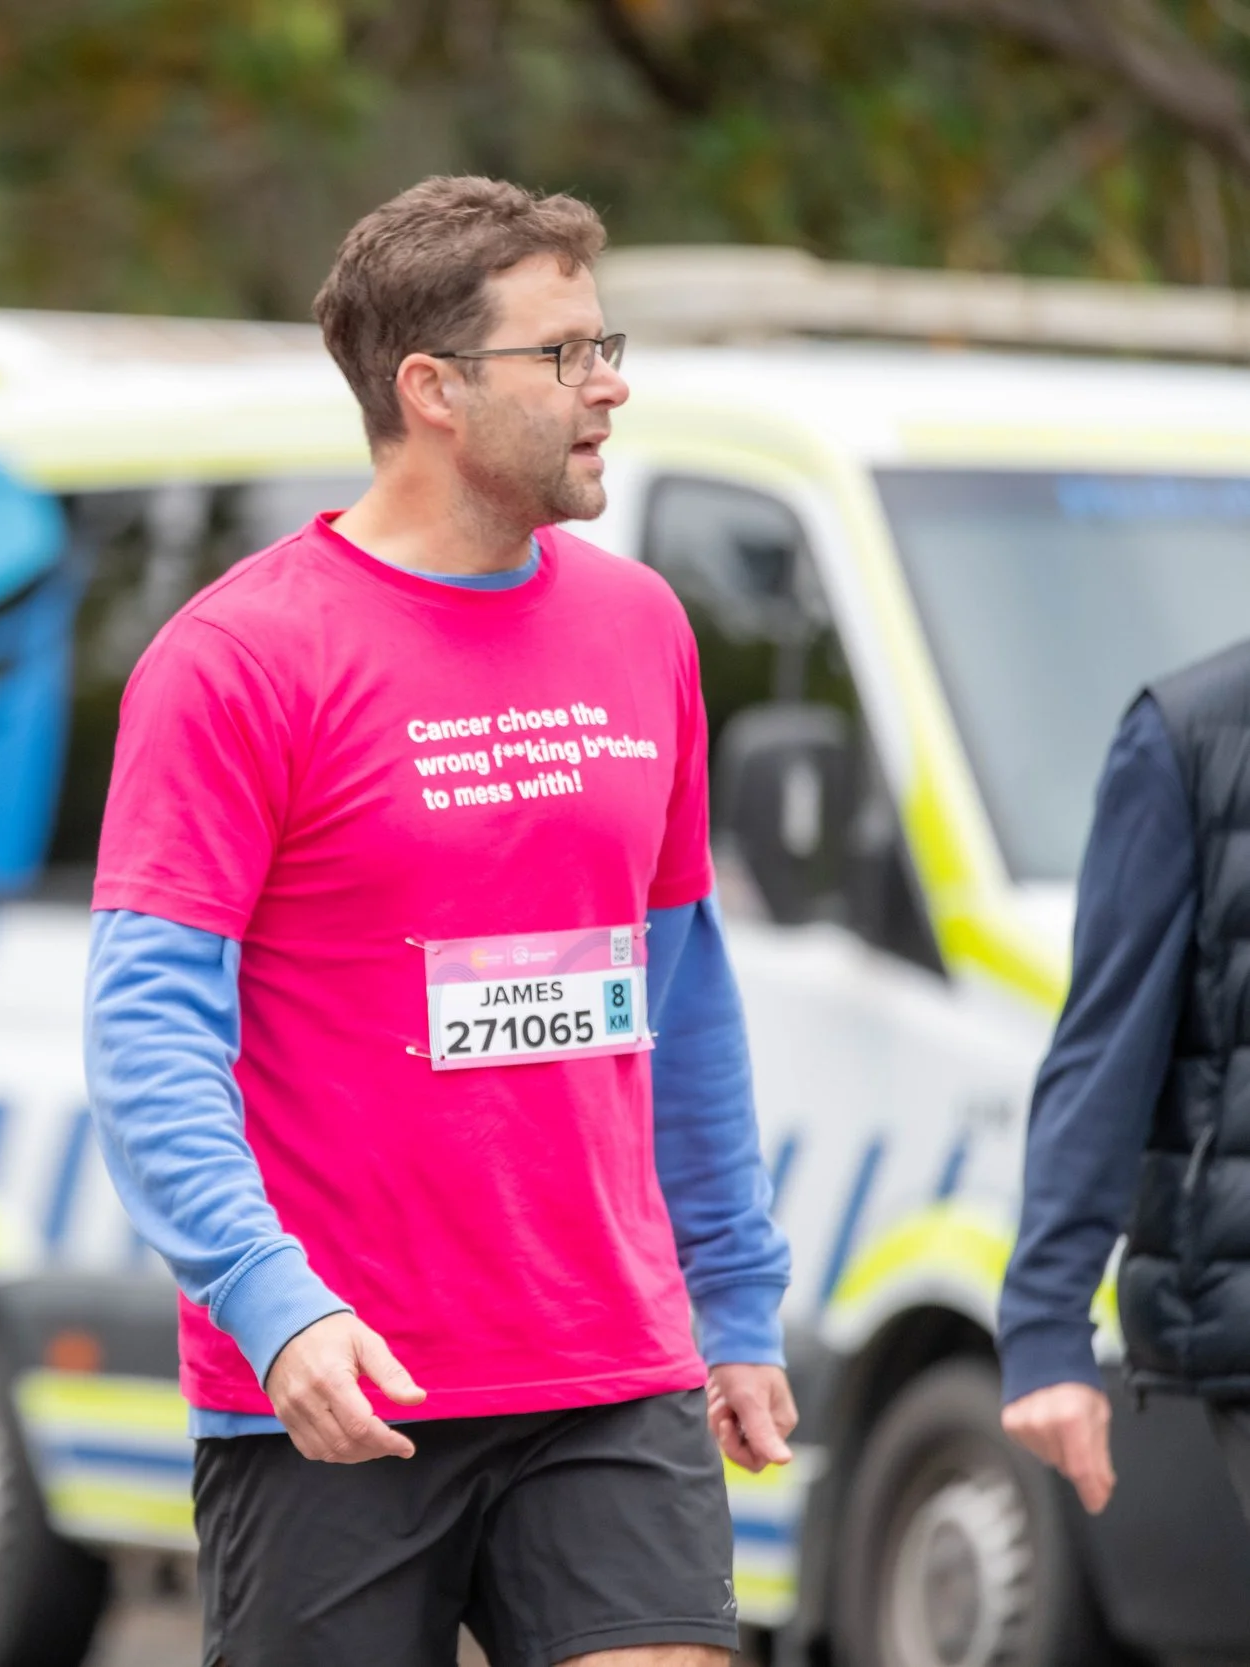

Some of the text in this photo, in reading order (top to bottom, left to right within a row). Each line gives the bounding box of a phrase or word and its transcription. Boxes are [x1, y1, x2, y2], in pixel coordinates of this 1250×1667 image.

[407, 702, 608, 743] Cancer chose the
[414, 750, 490, 775] wrong
[422, 770, 583, 811] to mess with!
[480, 981, 564, 1007] JAMES
[612, 983, 625, 1008] 8
[446, 1010, 594, 1055] 271065
[610, 1014, 629, 1030] KM
